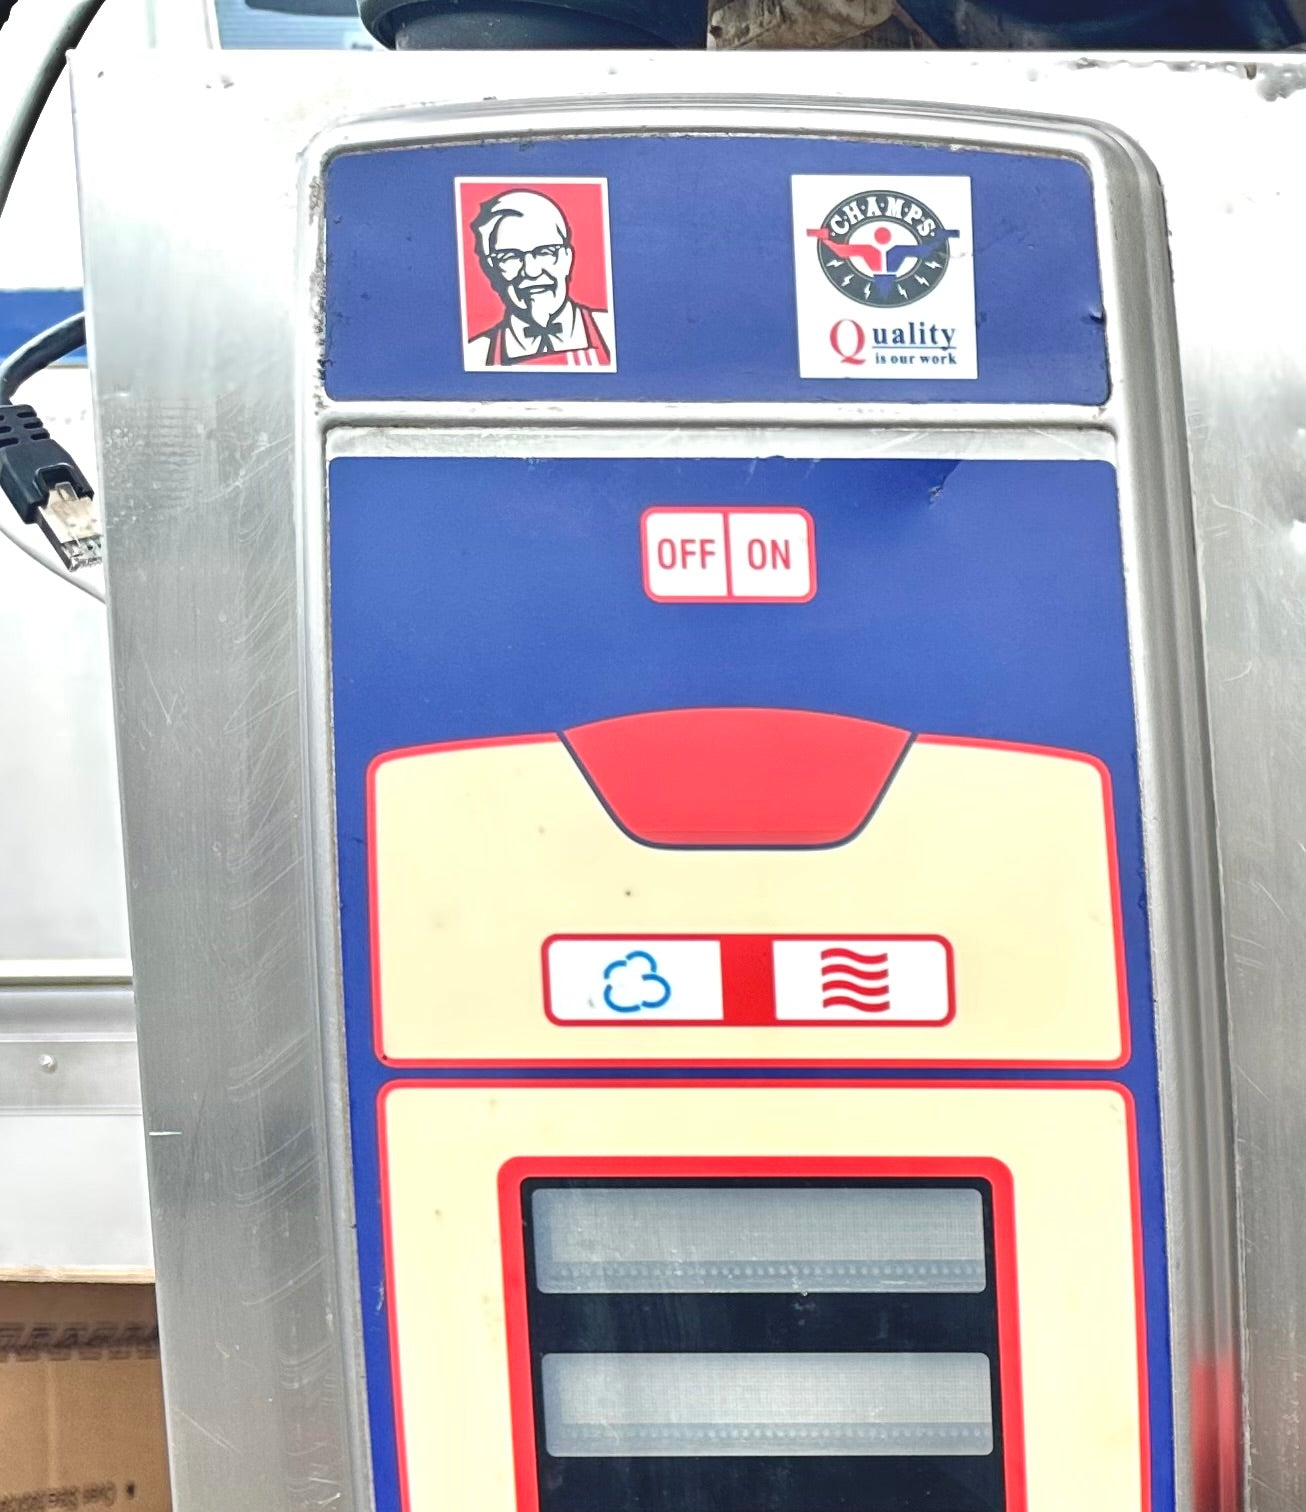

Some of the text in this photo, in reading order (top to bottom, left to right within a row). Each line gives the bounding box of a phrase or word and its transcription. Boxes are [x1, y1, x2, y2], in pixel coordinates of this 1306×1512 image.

[829, 318, 957, 366] Quality
[875, 352, 957, 365] is our work
[657, 538, 716, 570] OFF
[747, 538, 791, 570] ON
